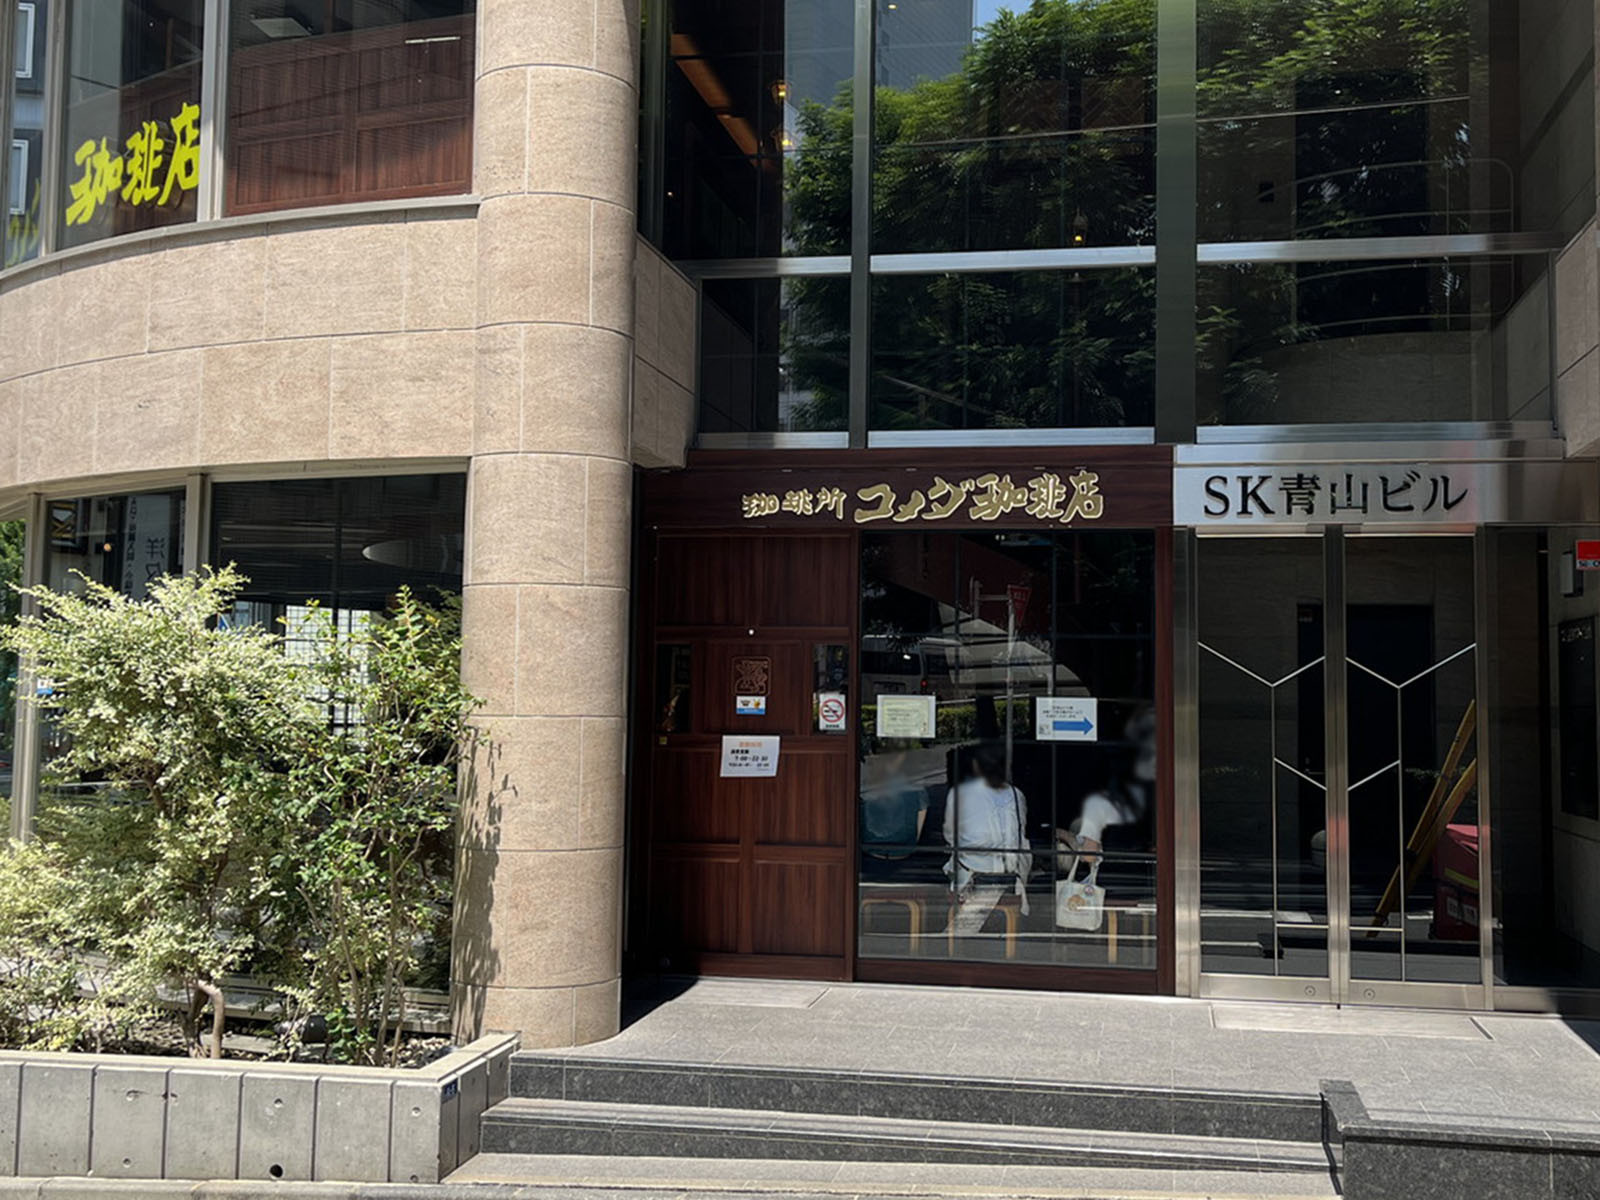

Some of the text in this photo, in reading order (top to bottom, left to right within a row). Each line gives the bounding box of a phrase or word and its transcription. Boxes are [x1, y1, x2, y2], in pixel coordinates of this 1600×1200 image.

[66, 102, 200, 226] 珈琲店
[1203, 470, 1469, 516] SK青山ビル
